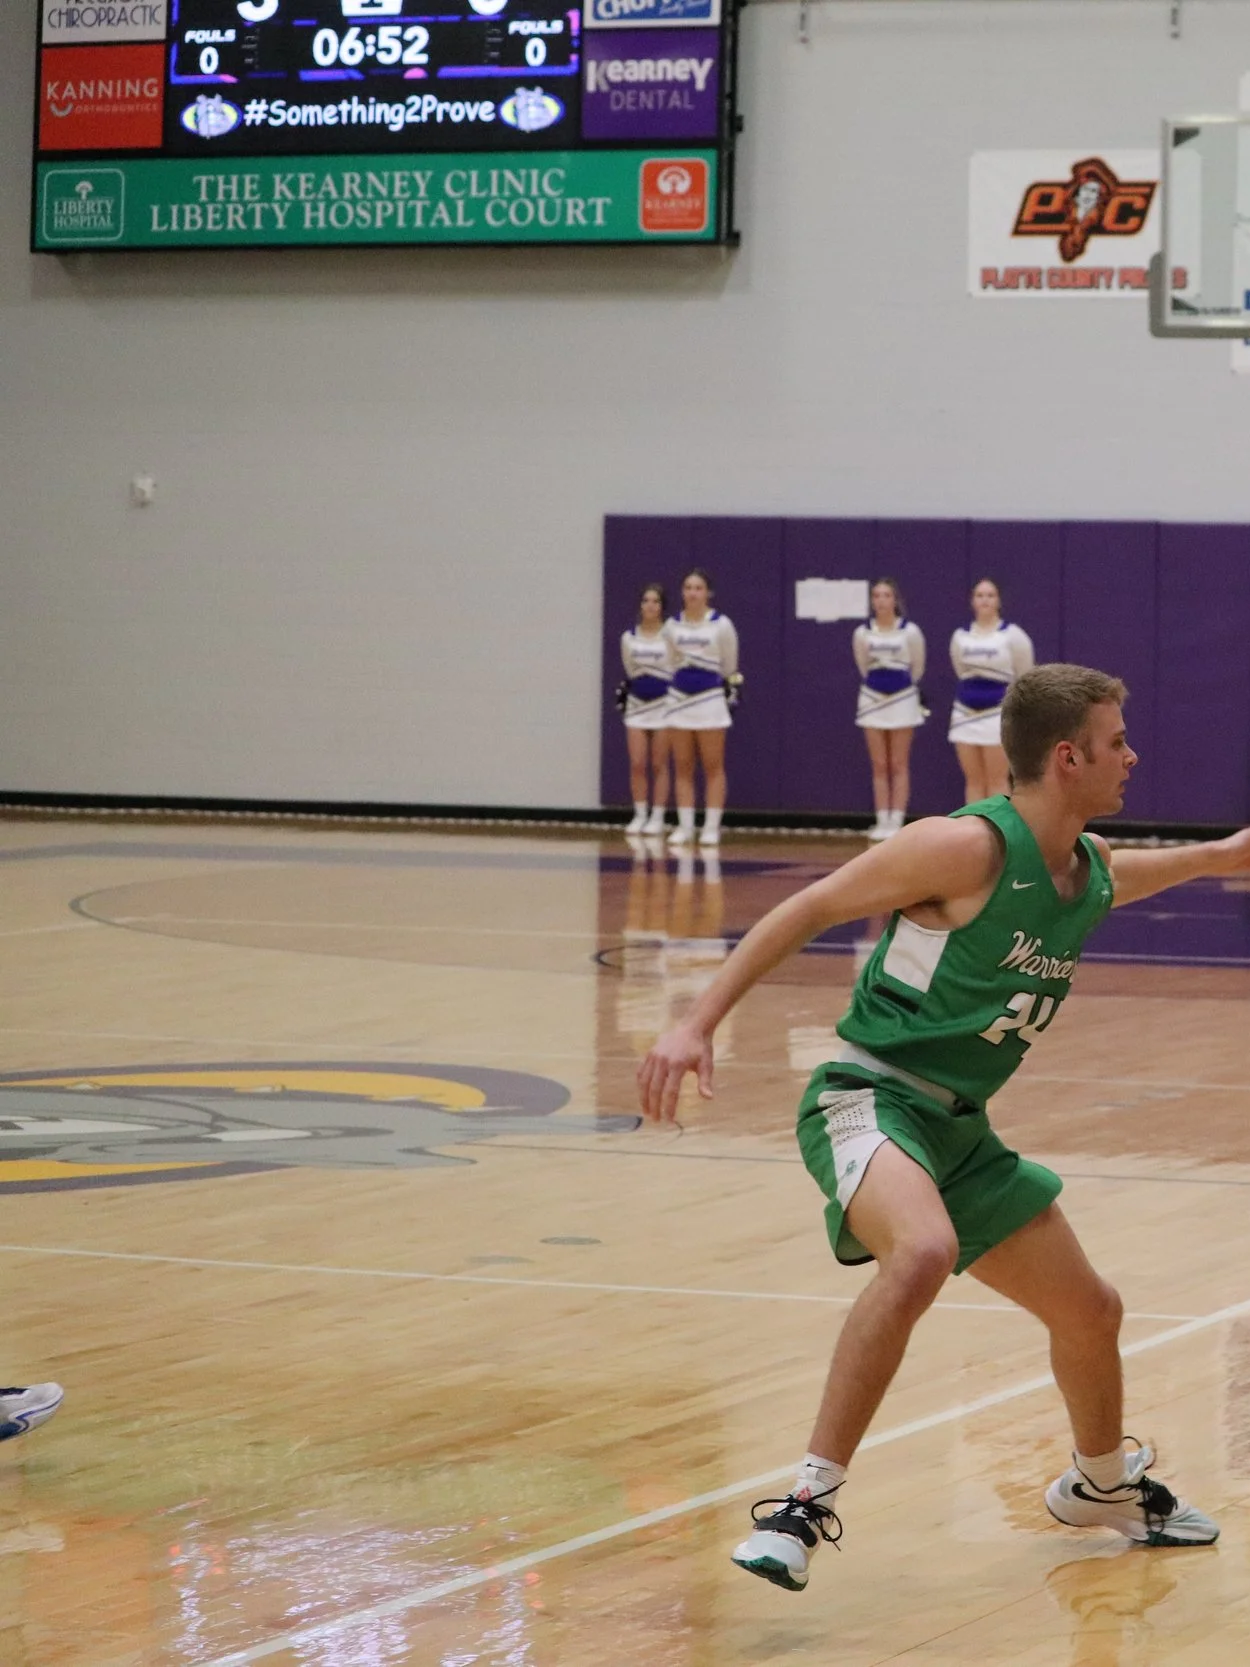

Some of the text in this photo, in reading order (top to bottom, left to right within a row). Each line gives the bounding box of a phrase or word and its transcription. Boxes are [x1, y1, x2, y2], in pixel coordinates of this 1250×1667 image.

[48, 4, 162, 28] CHIROPRACTIC
[508, 20, 564, 35] FOULS
[185, 29, 237, 44] FOULS
[312, 25, 430, 67] 06:52
[199, 46, 219, 75] 0
[525, 37, 547, 67] 0
[47, 78, 159, 101] KANNING
[610, 90, 696, 111] DENTAL
[243, 94, 496, 132] #Something2Prove
[193, 168, 566, 203] THE KEARNEY CLINIC
[54, 199, 114, 215] LIBERTY
[150, 197, 612, 233] LIBERTY HOSPITAL COURT
[54, 214, 114, 229] HOSPITAL
[1047, 267, 1115, 290] COUNTY
